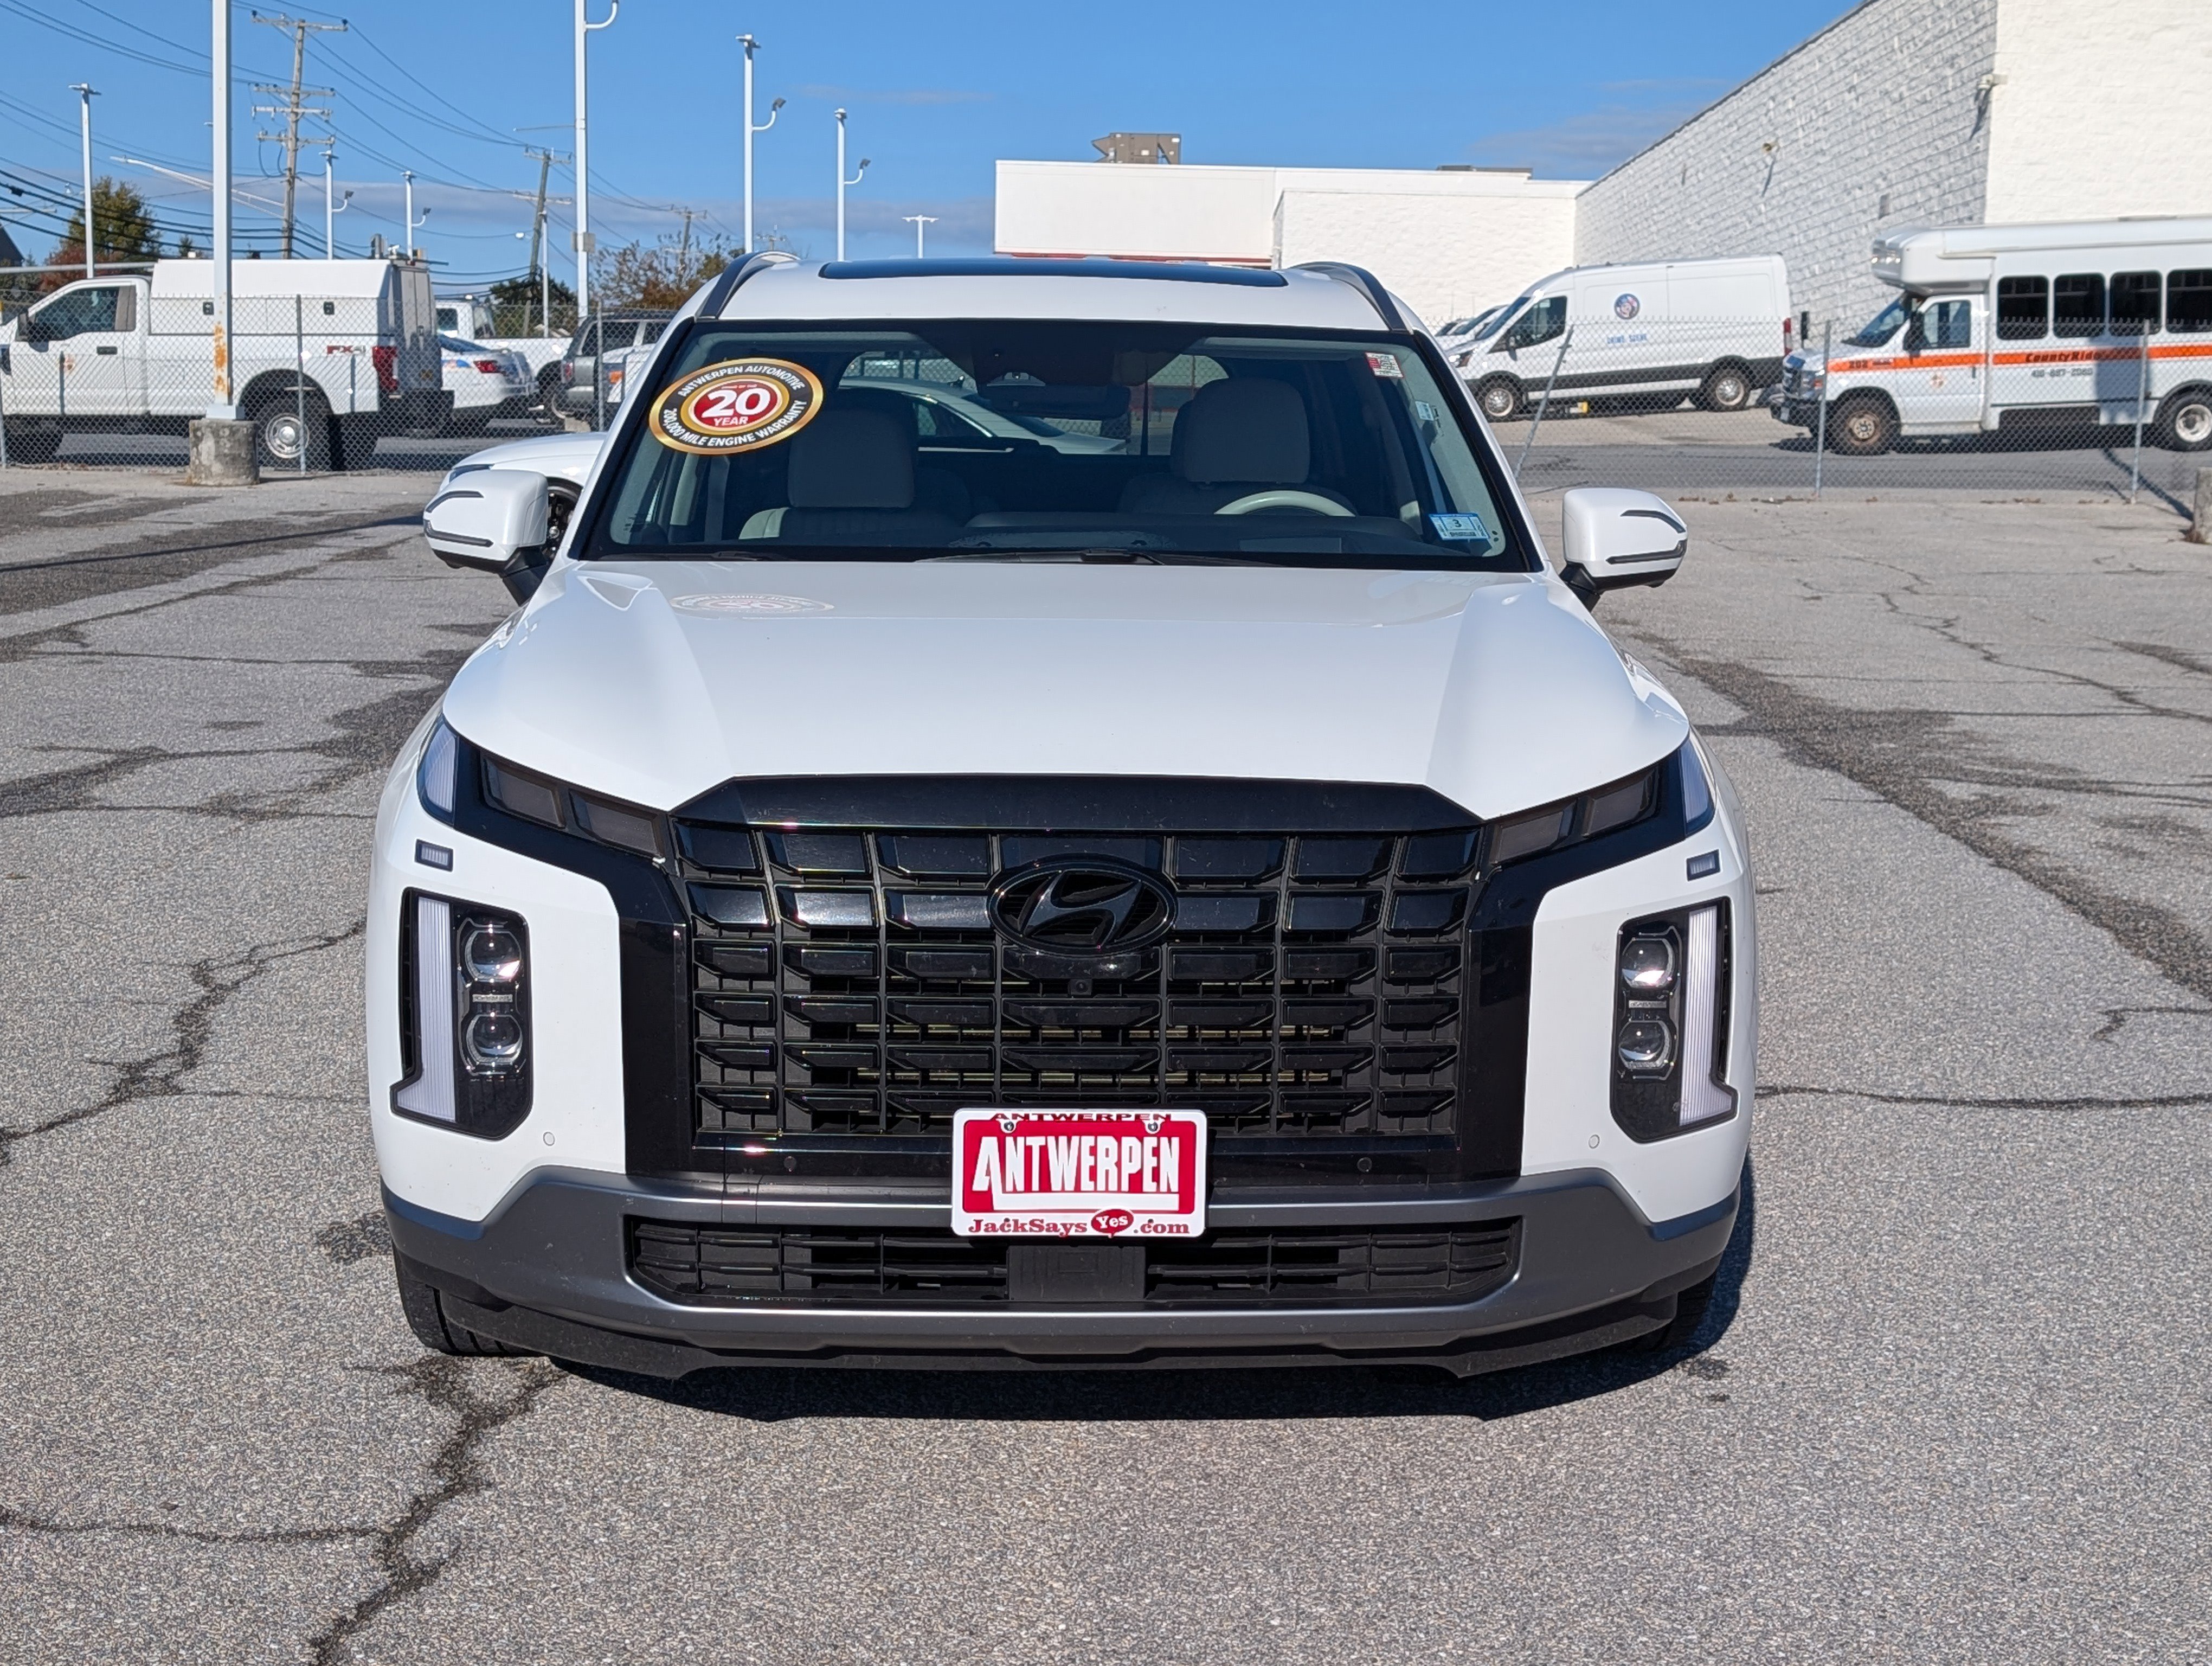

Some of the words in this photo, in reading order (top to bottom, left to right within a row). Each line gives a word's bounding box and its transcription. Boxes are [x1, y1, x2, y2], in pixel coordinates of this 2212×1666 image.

[678, 366, 743, 398] ANTWERPEN
[744, 365, 806, 391] AUTOMOTIVE
[701, 388, 771, 418] 20
[663, 407, 684, 439] 200,000
[679, 432, 708, 446] MILE
[707, 432, 756, 447] ENGINE
[755, 400, 807, 439] WARRANTY
[713, 416, 749, 426] YEAR
[1452, 519, 1462, 528] 3
[991, 1113, 1172, 1121] ANTWERPEN
[972, 1136, 1180, 1193] ANTWERPEN
